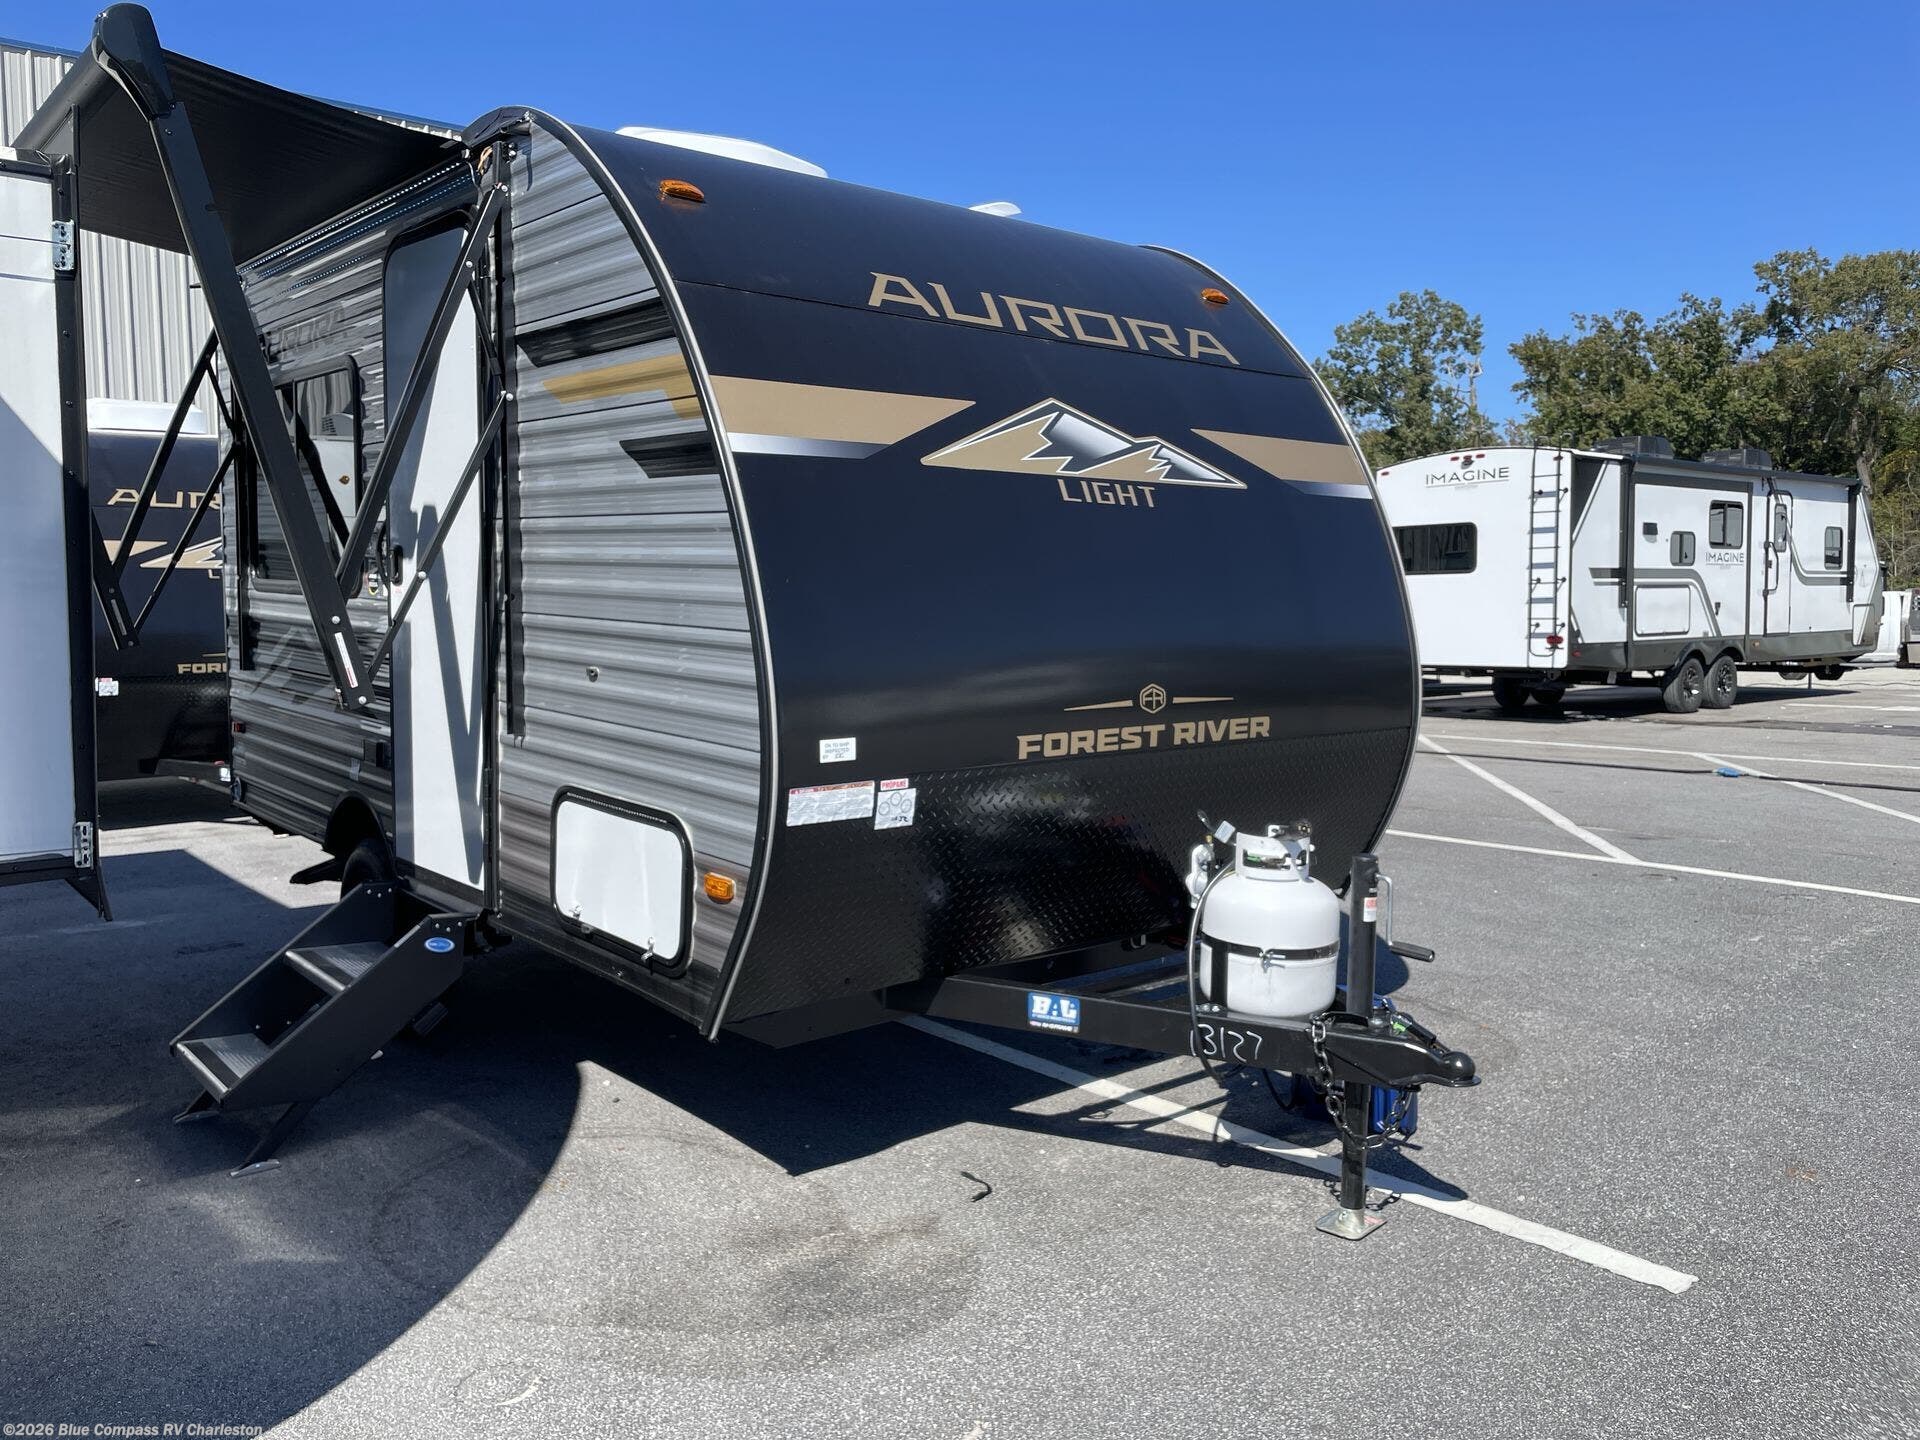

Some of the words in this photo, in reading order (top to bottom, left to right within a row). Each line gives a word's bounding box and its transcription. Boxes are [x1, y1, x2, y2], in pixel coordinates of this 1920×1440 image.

[867, 271, 1241, 366] AURORA
[1426, 467, 1509, 485] IMAGINE
[1057, 478, 1156, 508] LIGHT
[1705, 552, 1744, 563] IMAGINE
[1017, 724, 1166, 760] FOREST
[1172, 716, 1271, 746] RIVER
